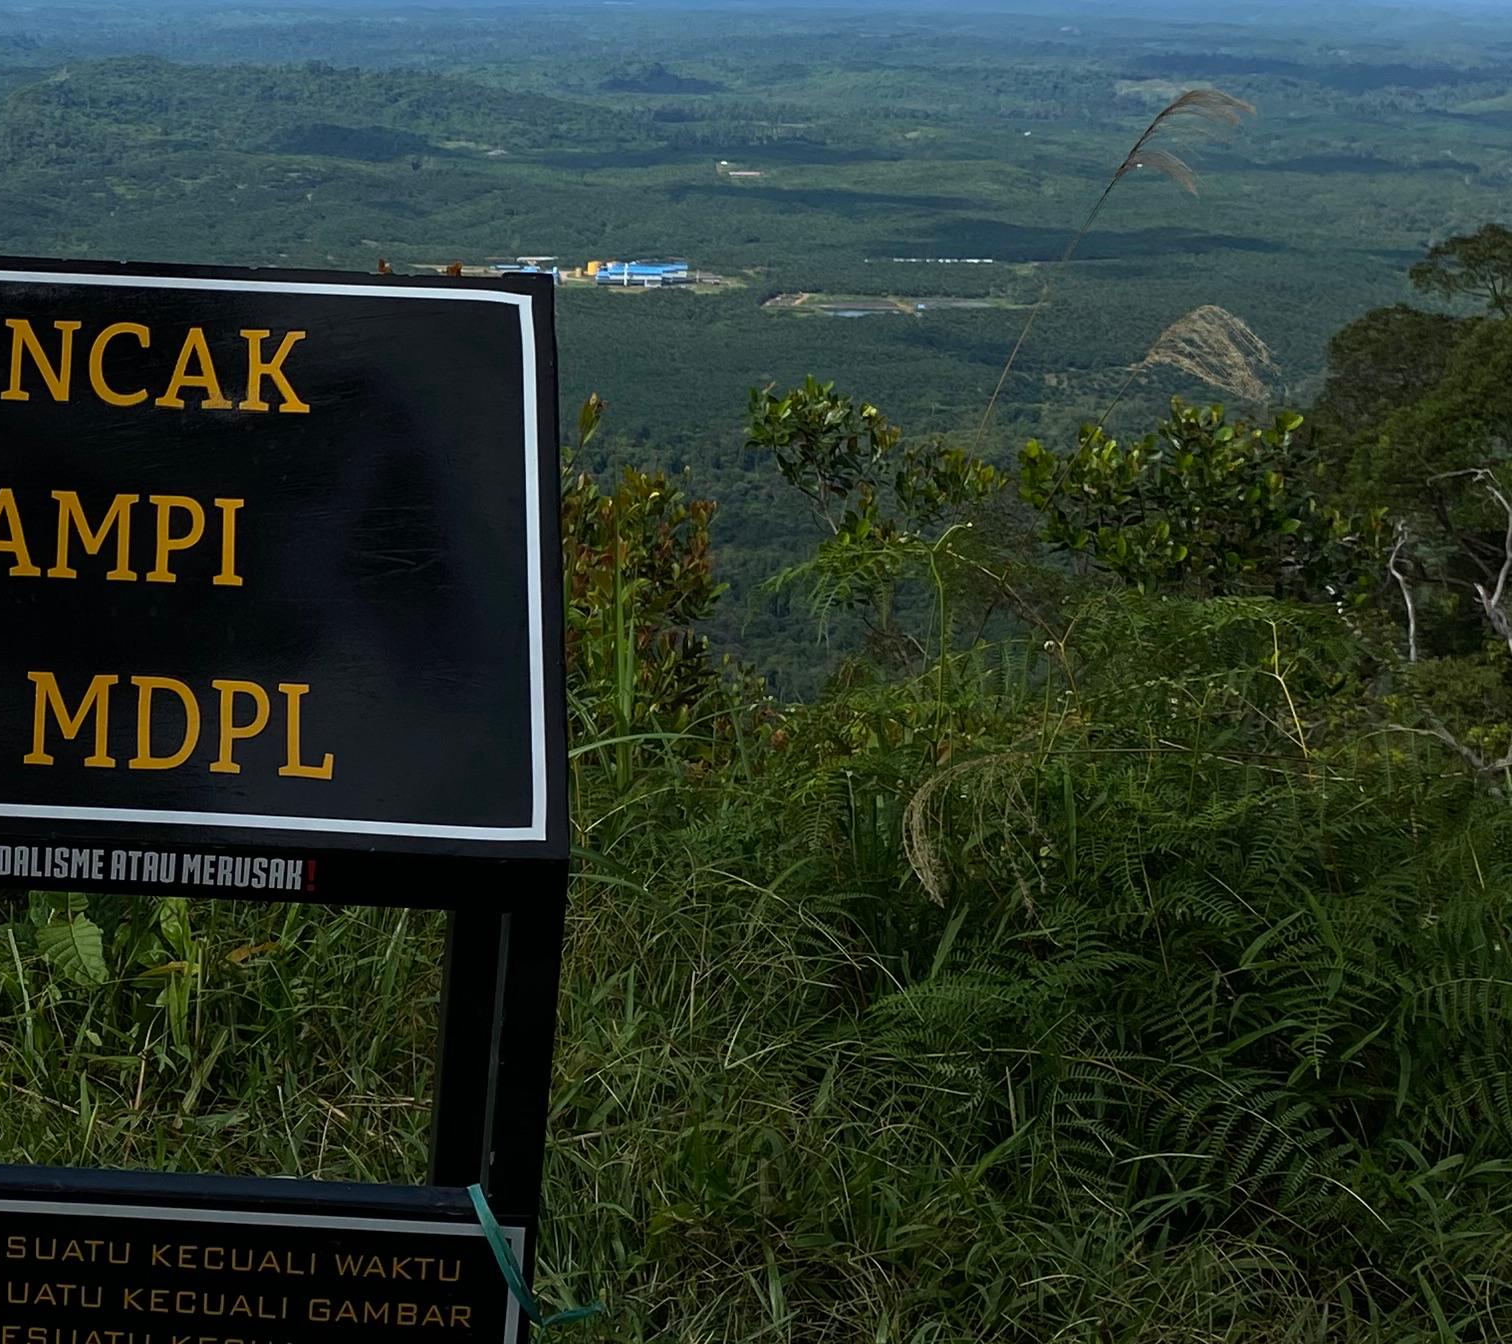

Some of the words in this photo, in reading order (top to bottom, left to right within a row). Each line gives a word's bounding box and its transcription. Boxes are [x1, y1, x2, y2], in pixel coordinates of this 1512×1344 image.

[24, 672, 333, 779] MDPL
[111, 850, 176, 883] ATAU
[182, 854, 316, 892] MERUSAK!
[152, 1244, 315, 1274] KECUALI
[336, 1254, 460, 1281] WAKTU
[124, 1288, 287, 1319] KECUALI
[309, 1299, 471, 1327] GAMBAR
